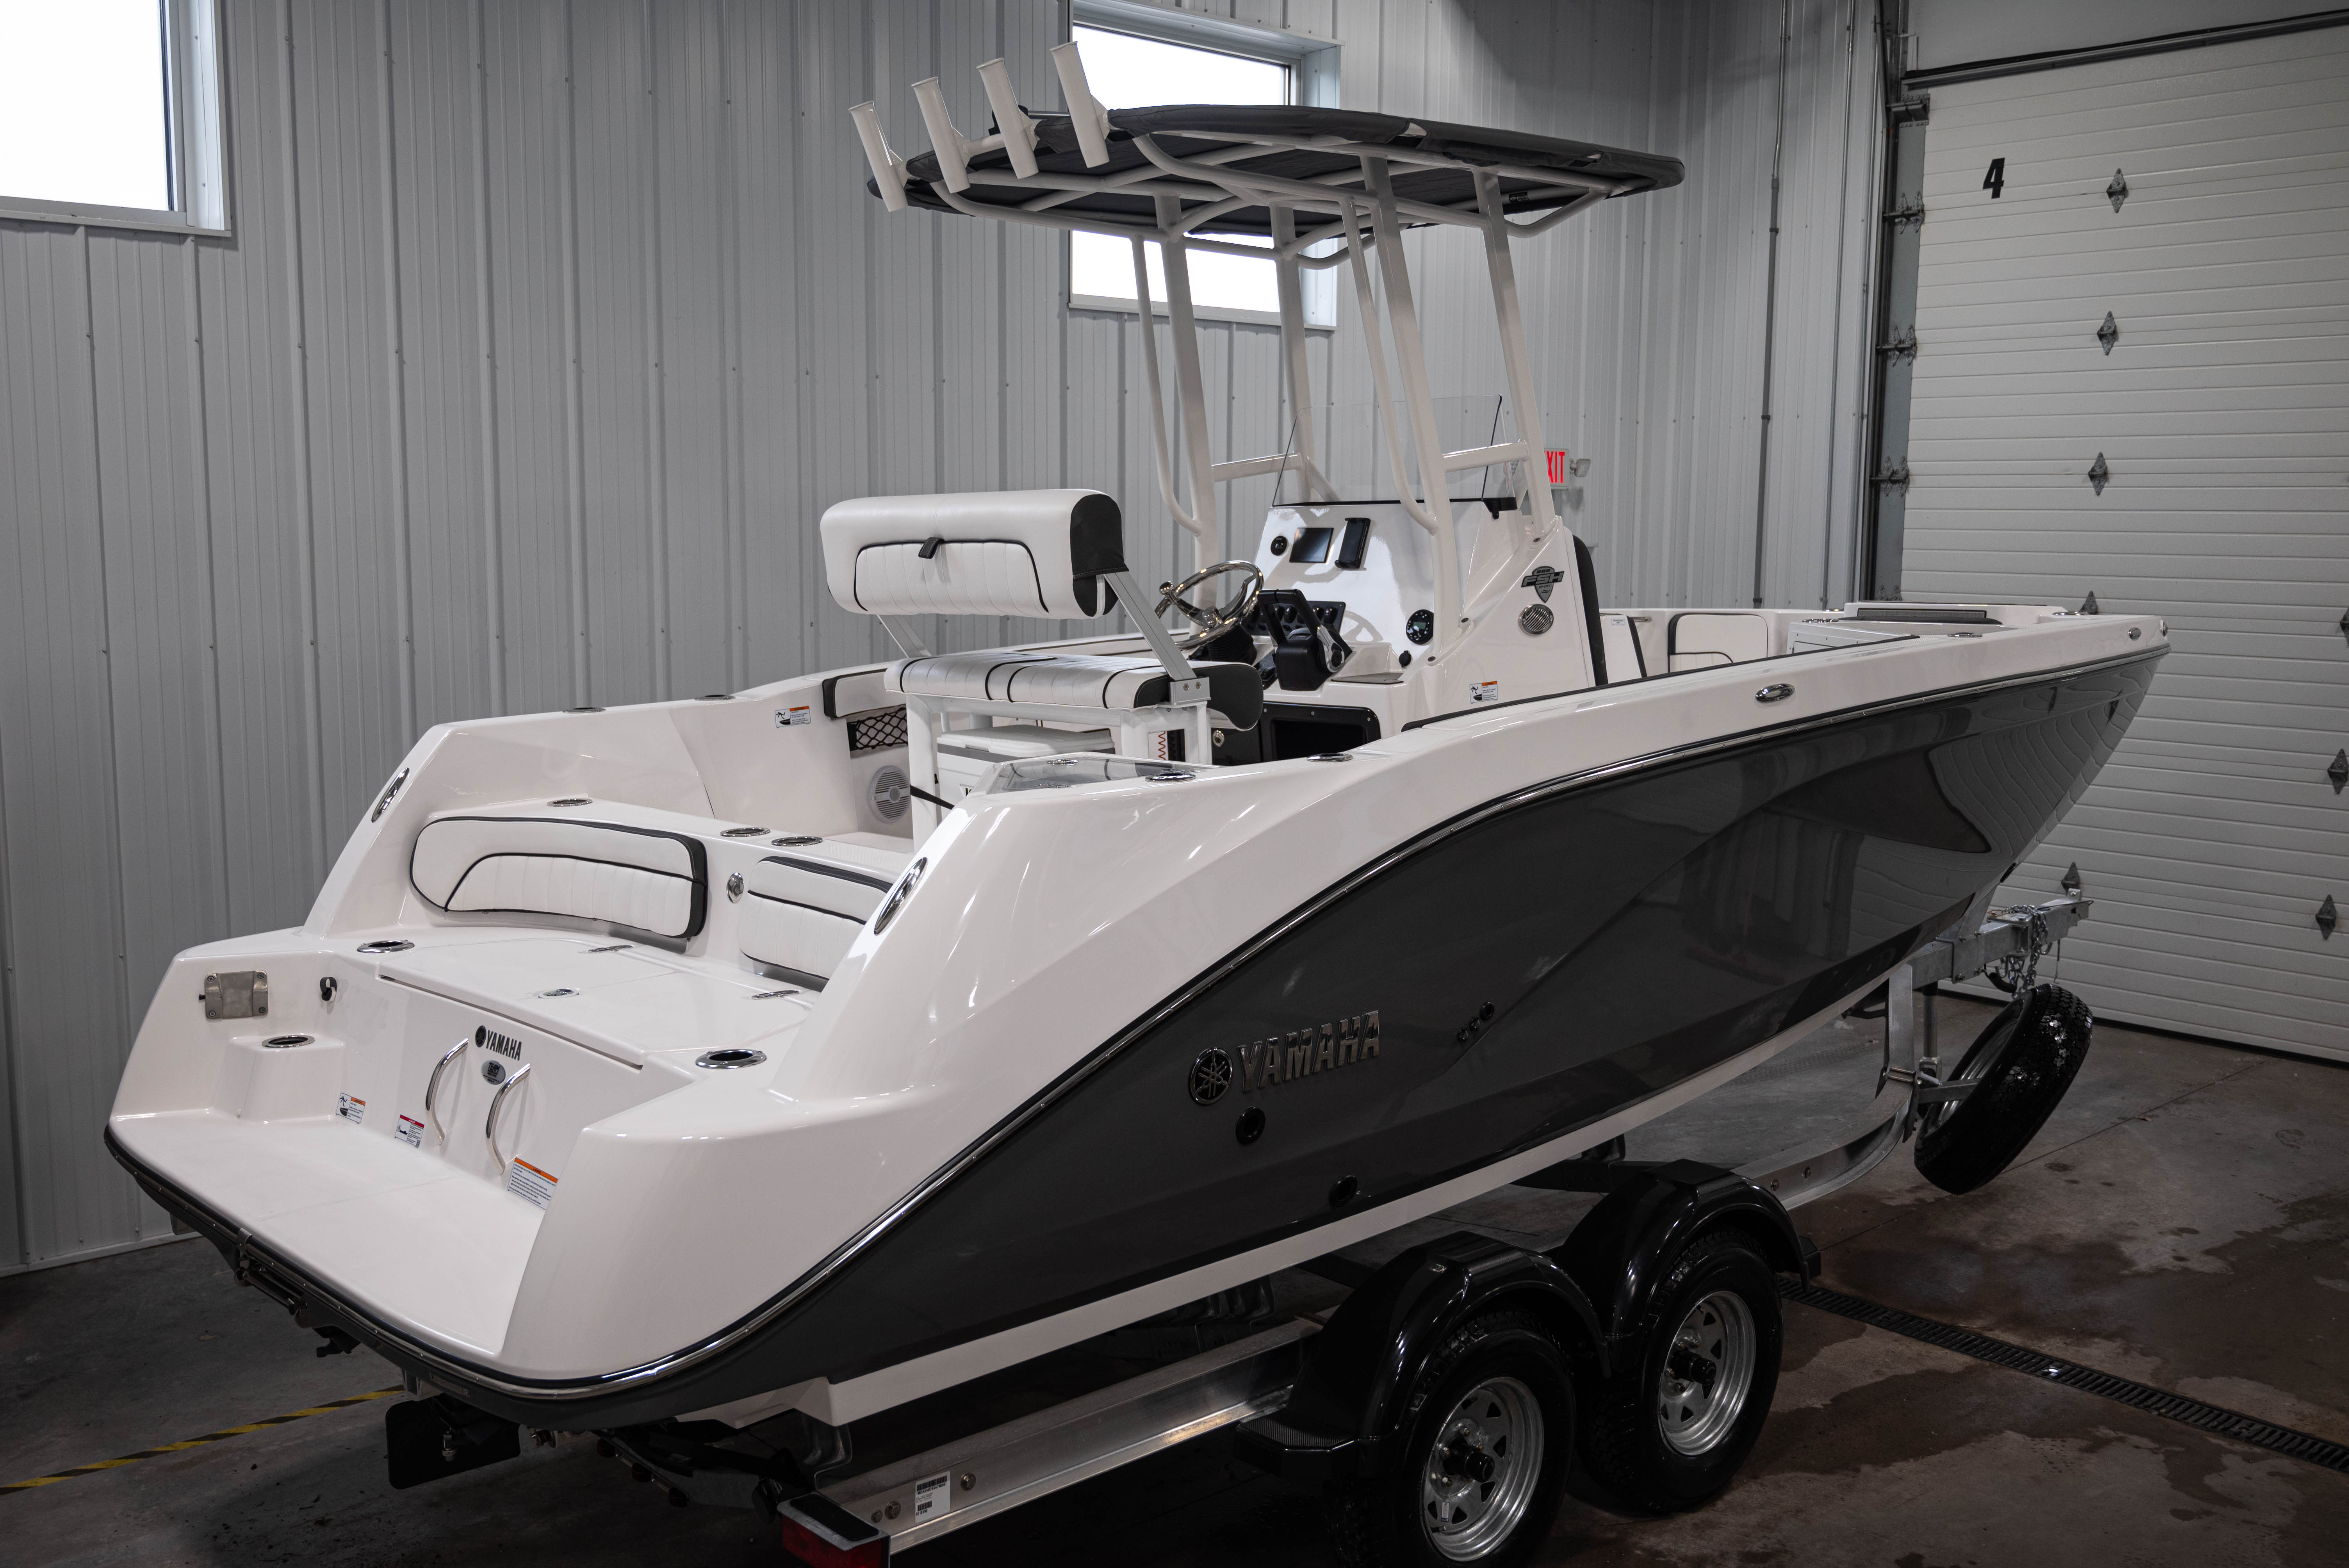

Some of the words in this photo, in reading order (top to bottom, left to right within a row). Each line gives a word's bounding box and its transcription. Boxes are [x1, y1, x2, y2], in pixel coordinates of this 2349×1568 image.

[1983, 157, 2005, 200] 4
[1544, 451, 1565, 484] XIT
[1523, 572, 1564, 586] FSH
[486, 1029, 522, 1061] YAMAHA
[1237, 1010, 1380, 1093] YAMAHA
[488, 1062, 501, 1073] TEAM
